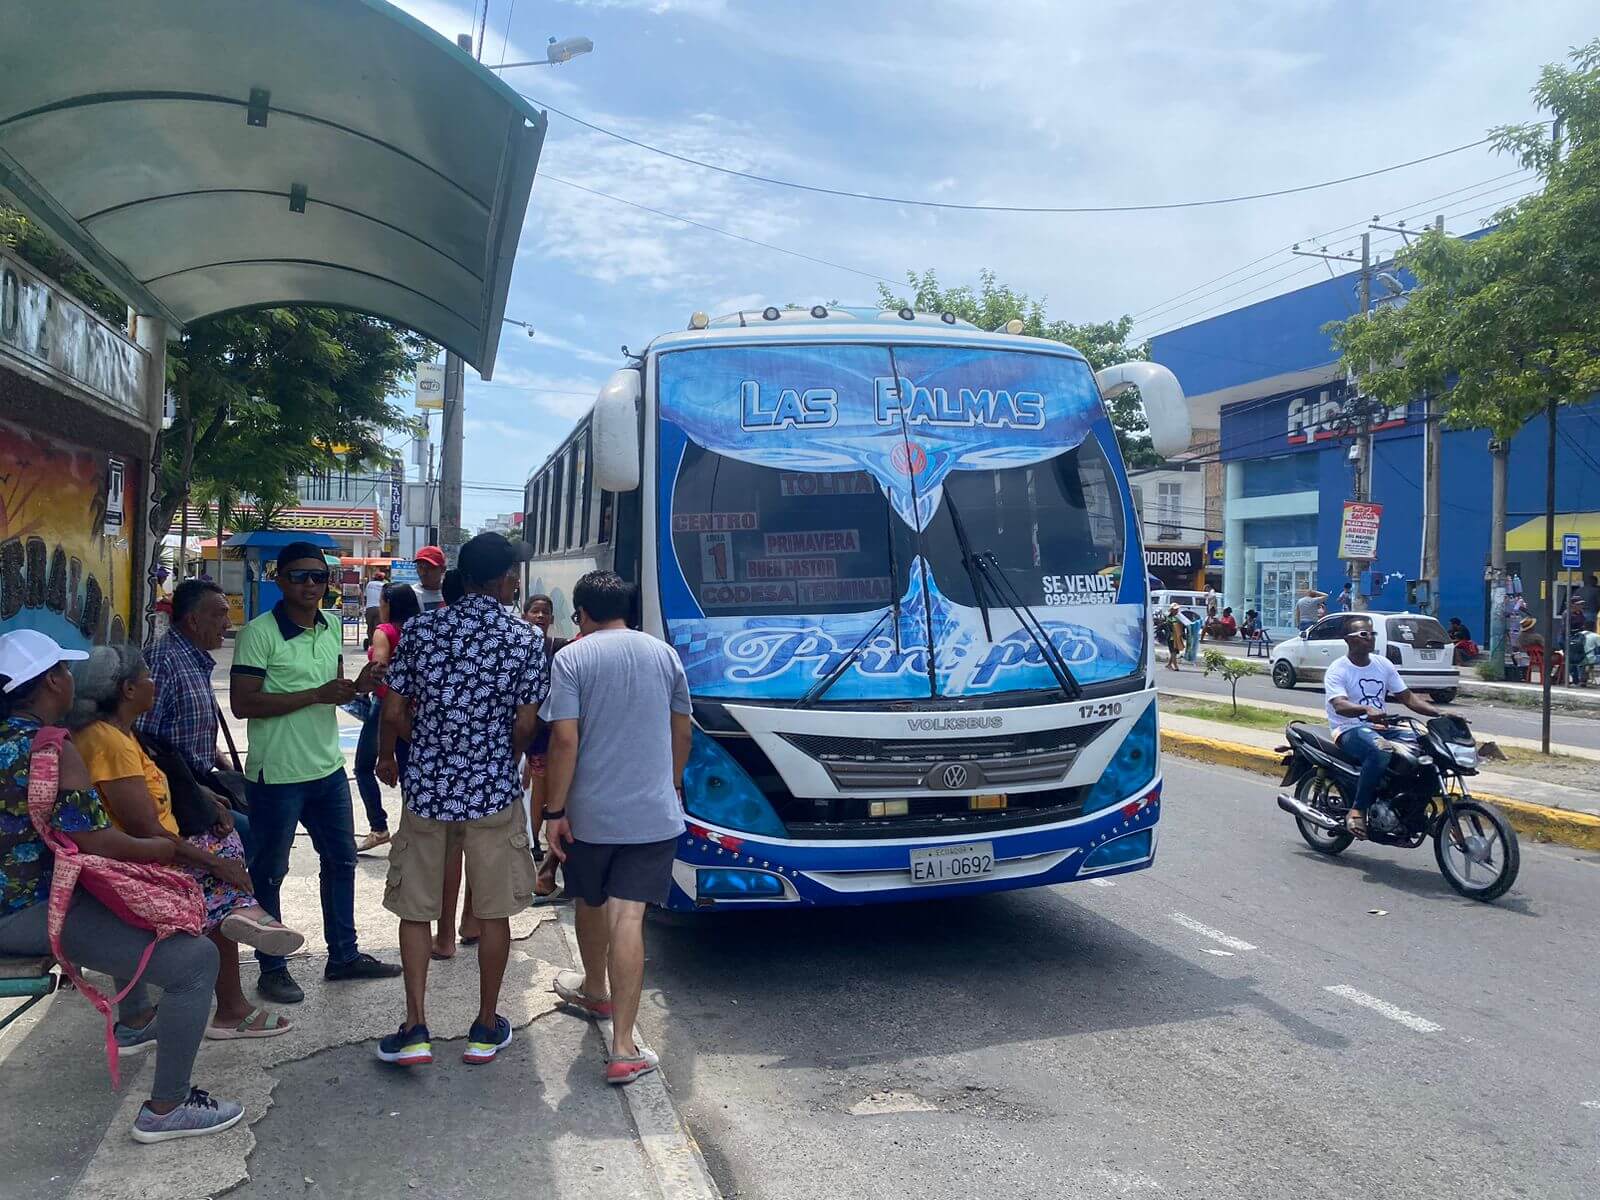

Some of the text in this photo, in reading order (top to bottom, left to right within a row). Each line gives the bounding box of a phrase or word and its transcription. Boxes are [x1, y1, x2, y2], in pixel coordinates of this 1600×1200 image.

[740, 376, 1045, 431] LAS PALMAS
[783, 473, 873, 494] TOLITA
[674, 513, 756, 531] CENTRO
[767, 532, 856, 553] PRIMAVERA
[708, 543, 727, 580] 1
[748, 559, 835, 577] BUEN PASTOR
[1042, 574, 1116, 593] SE VENDE
[702, 585, 793, 604] CODESA
[1079, 702, 1122, 719] 17-210
[907, 716, 1003, 731] VOLKSBUS
